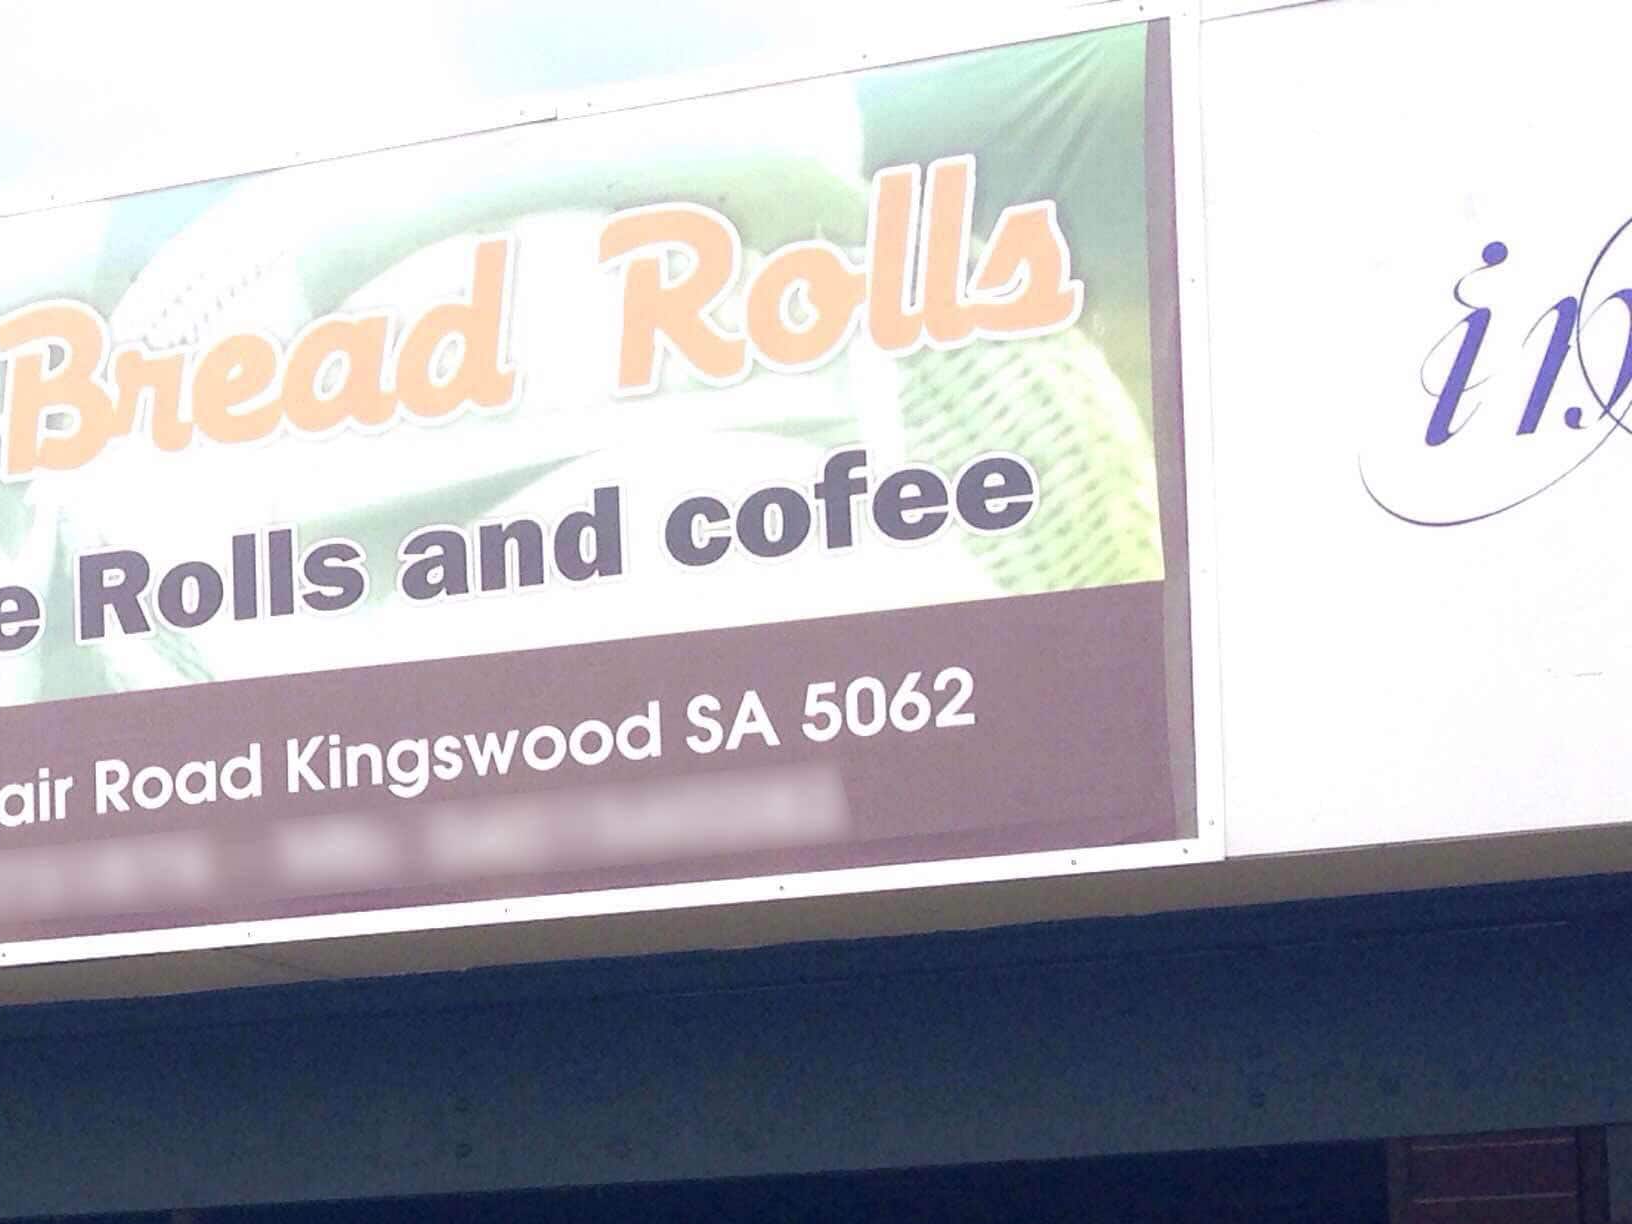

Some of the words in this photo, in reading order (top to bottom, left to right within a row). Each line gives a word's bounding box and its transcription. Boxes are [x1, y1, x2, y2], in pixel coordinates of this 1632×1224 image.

[598, 161, 1078, 389] Rolls
[79, 528, 366, 640] Rolls
[401, 485, 623, 601] and
[665, 448, 1034, 567] cofee
[94, 742, 263, 814] Road
[285, 700, 663, 800] Kingswood
[686, 690, 780, 754] SA
[801, 666, 976, 744] 5062
